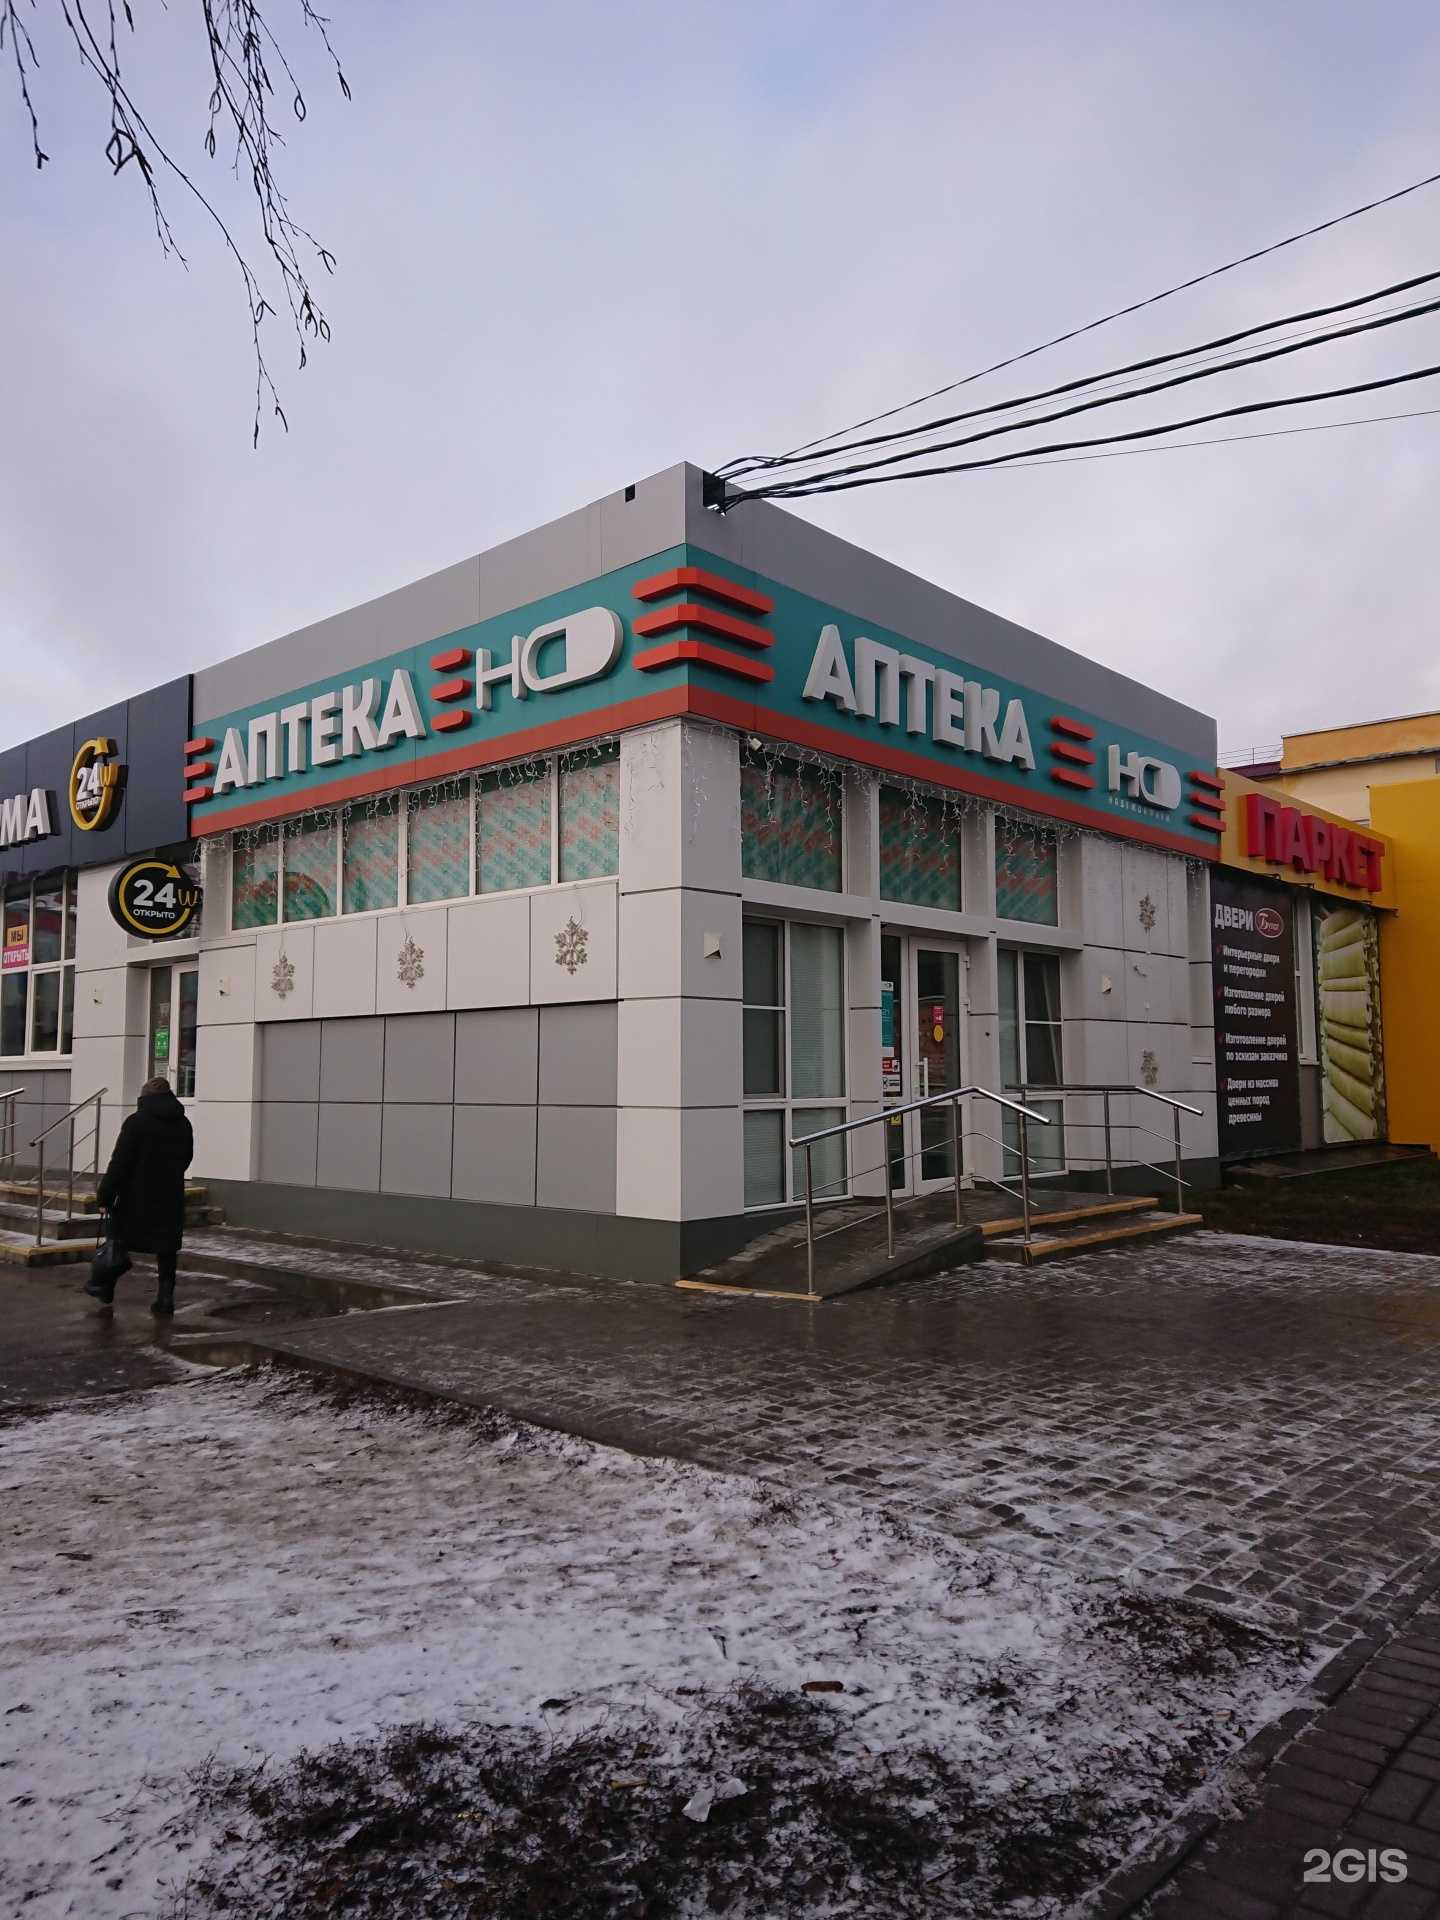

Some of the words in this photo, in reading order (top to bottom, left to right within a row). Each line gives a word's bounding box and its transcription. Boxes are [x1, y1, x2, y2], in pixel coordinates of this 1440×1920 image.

[802, 624, 1036, 771] АПТЕКА
[212, 669, 426, 795] АПТЕКА
[1247, 793, 1386, 893] ПАРКЕТ
[133, 908, 176, 919] ОТКРЫТО
[1214, 903, 1254, 932] ДВЕРИ
[10, 928, 24, 943] МЫ
[1223, 945, 1262, 962] Интерьерные
[1263, 953, 1280, 966] двери
[1229, 965, 1267, 979] перегородки
[1224, 986, 1264, 1001] Изготовление
[1265, 991, 1285, 1004] дверей
[1224, 1003, 1247, 1016] любого
[1247, 1007, 1271, 1019] размера
[1225, 1033, 1266, 1045] Изготовление
[1266, 1034, 1287, 1048] дверей
[1226, 1052, 1234, 1061] по
[1235, 1052, 1259, 1061] эскизам
[1260, 1052, 1288, 1061] заказчика
[1227, 1077, 1246, 1091] Двери
[1247, 1079, 1255, 1089] из
[1255, 1079, 1279, 1088] массива
[1227, 1096, 1251, 1108] ценных
[1252, 1095, 1270, 1107] пород
[1228, 1112, 1262, 1125] древесины
